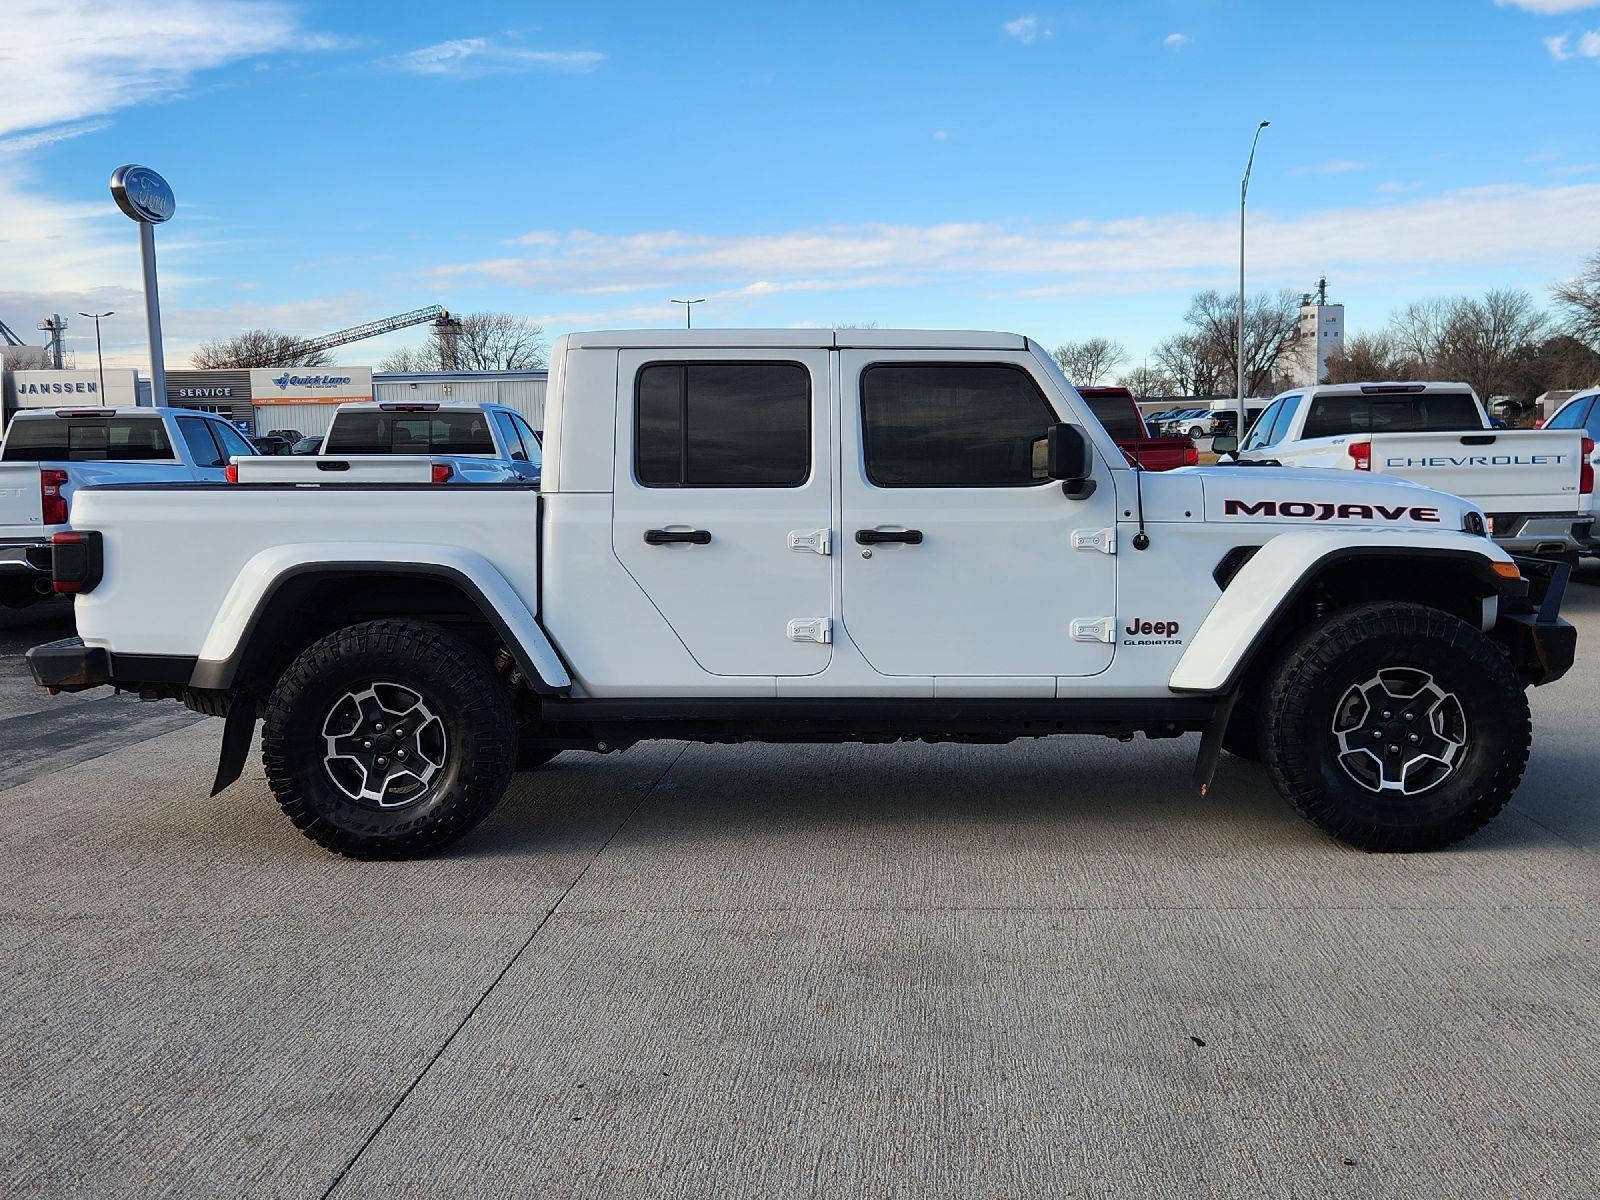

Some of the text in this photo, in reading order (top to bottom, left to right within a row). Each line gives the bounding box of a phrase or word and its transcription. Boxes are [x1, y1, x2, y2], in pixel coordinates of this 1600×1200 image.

[139, 176, 168, 213] Ford
[289, 375, 351, 386] Quick Lane
[18, 382, 98, 394] JANSSEN
[179, 387, 232, 397] SERVICE
[1387, 455, 1567, 467] CHEVROLET
[1224, 499, 1441, 522] MOJAVE
[1126, 618, 1179, 638] Jeep
